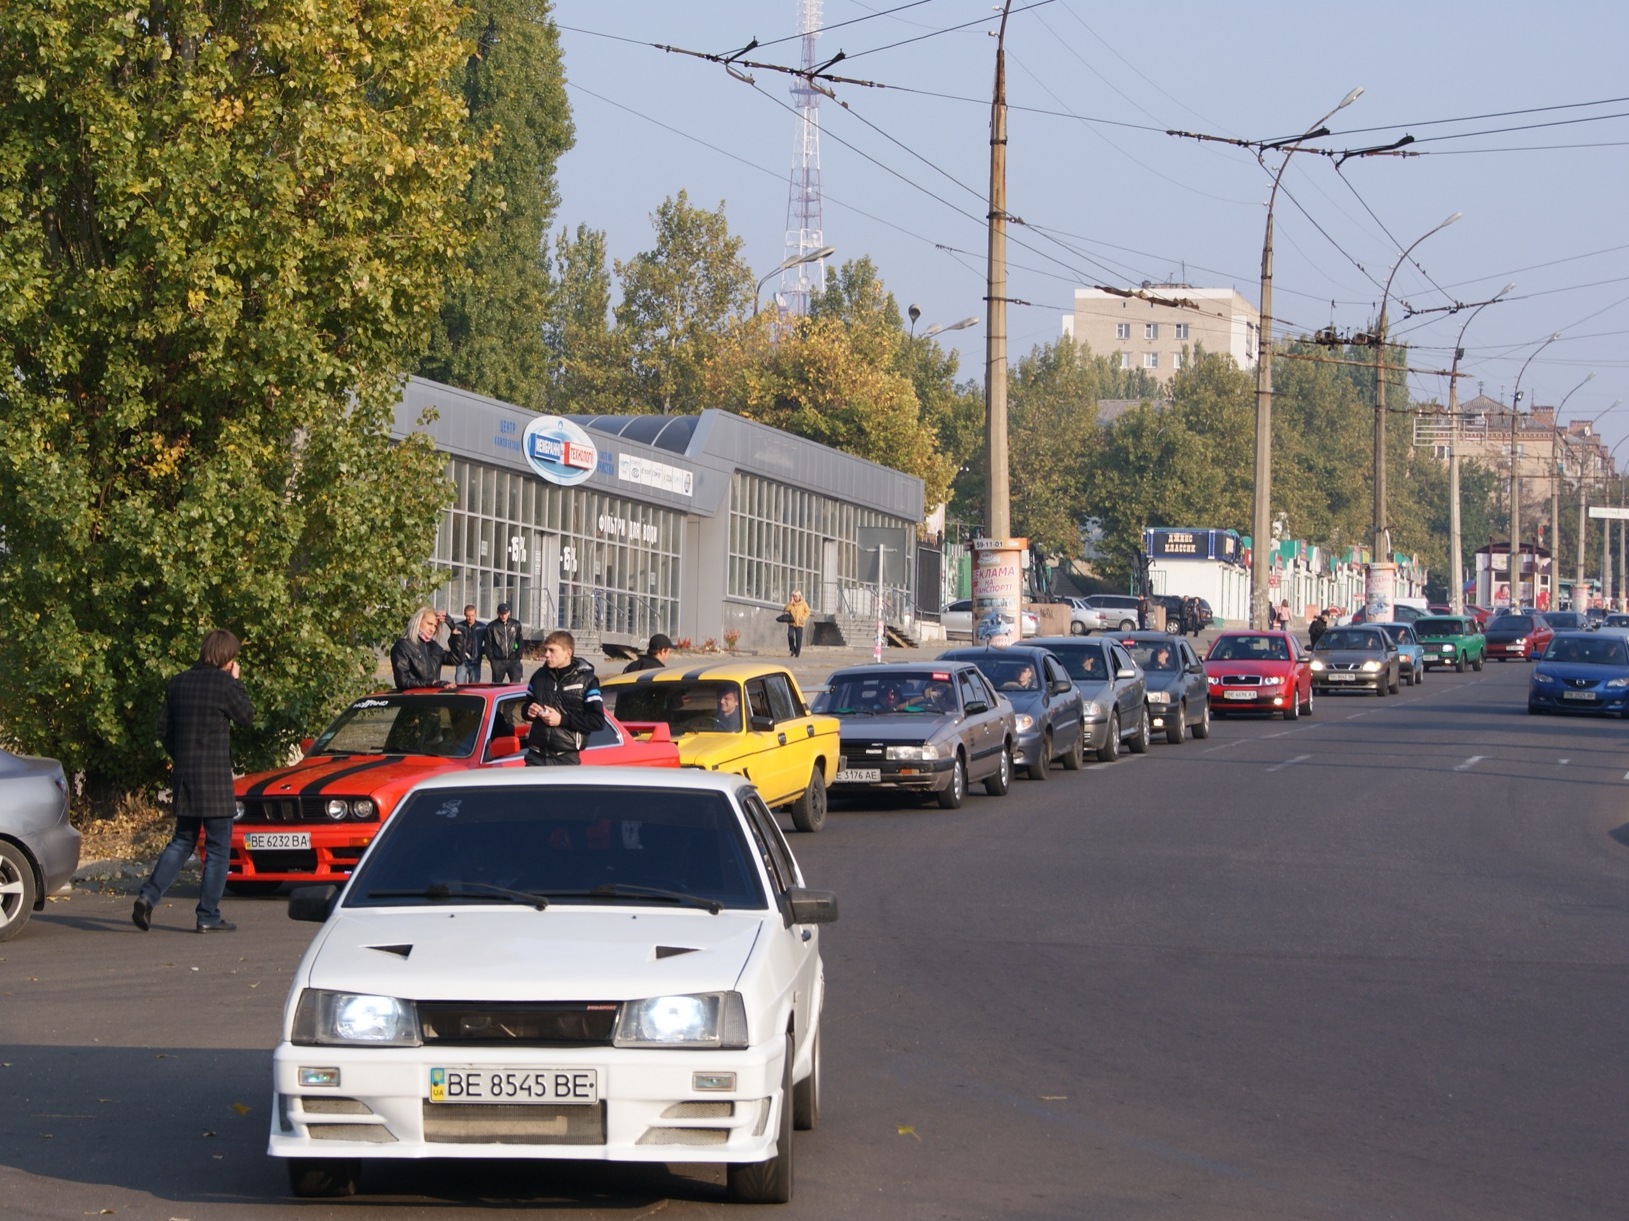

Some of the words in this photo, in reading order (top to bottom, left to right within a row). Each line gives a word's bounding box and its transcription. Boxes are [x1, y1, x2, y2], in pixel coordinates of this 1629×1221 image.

[1167, 533, 1193, 544] ДЖИНС
[976, 541, 1004, 549] 59-11-01
[1164, 543, 1196, 553] КЛАССИК
[845, 770, 863, 779] 3176
[866, 771, 877, 780] AE
[251, 835, 265, 847] BE
[267, 835, 290, 847] 6232
[293, 835, 308, 847] BA
[449, 1073, 483, 1097] BE
[490, 1073, 547, 1097] 8545
[555, 1074, 590, 1098] BE
